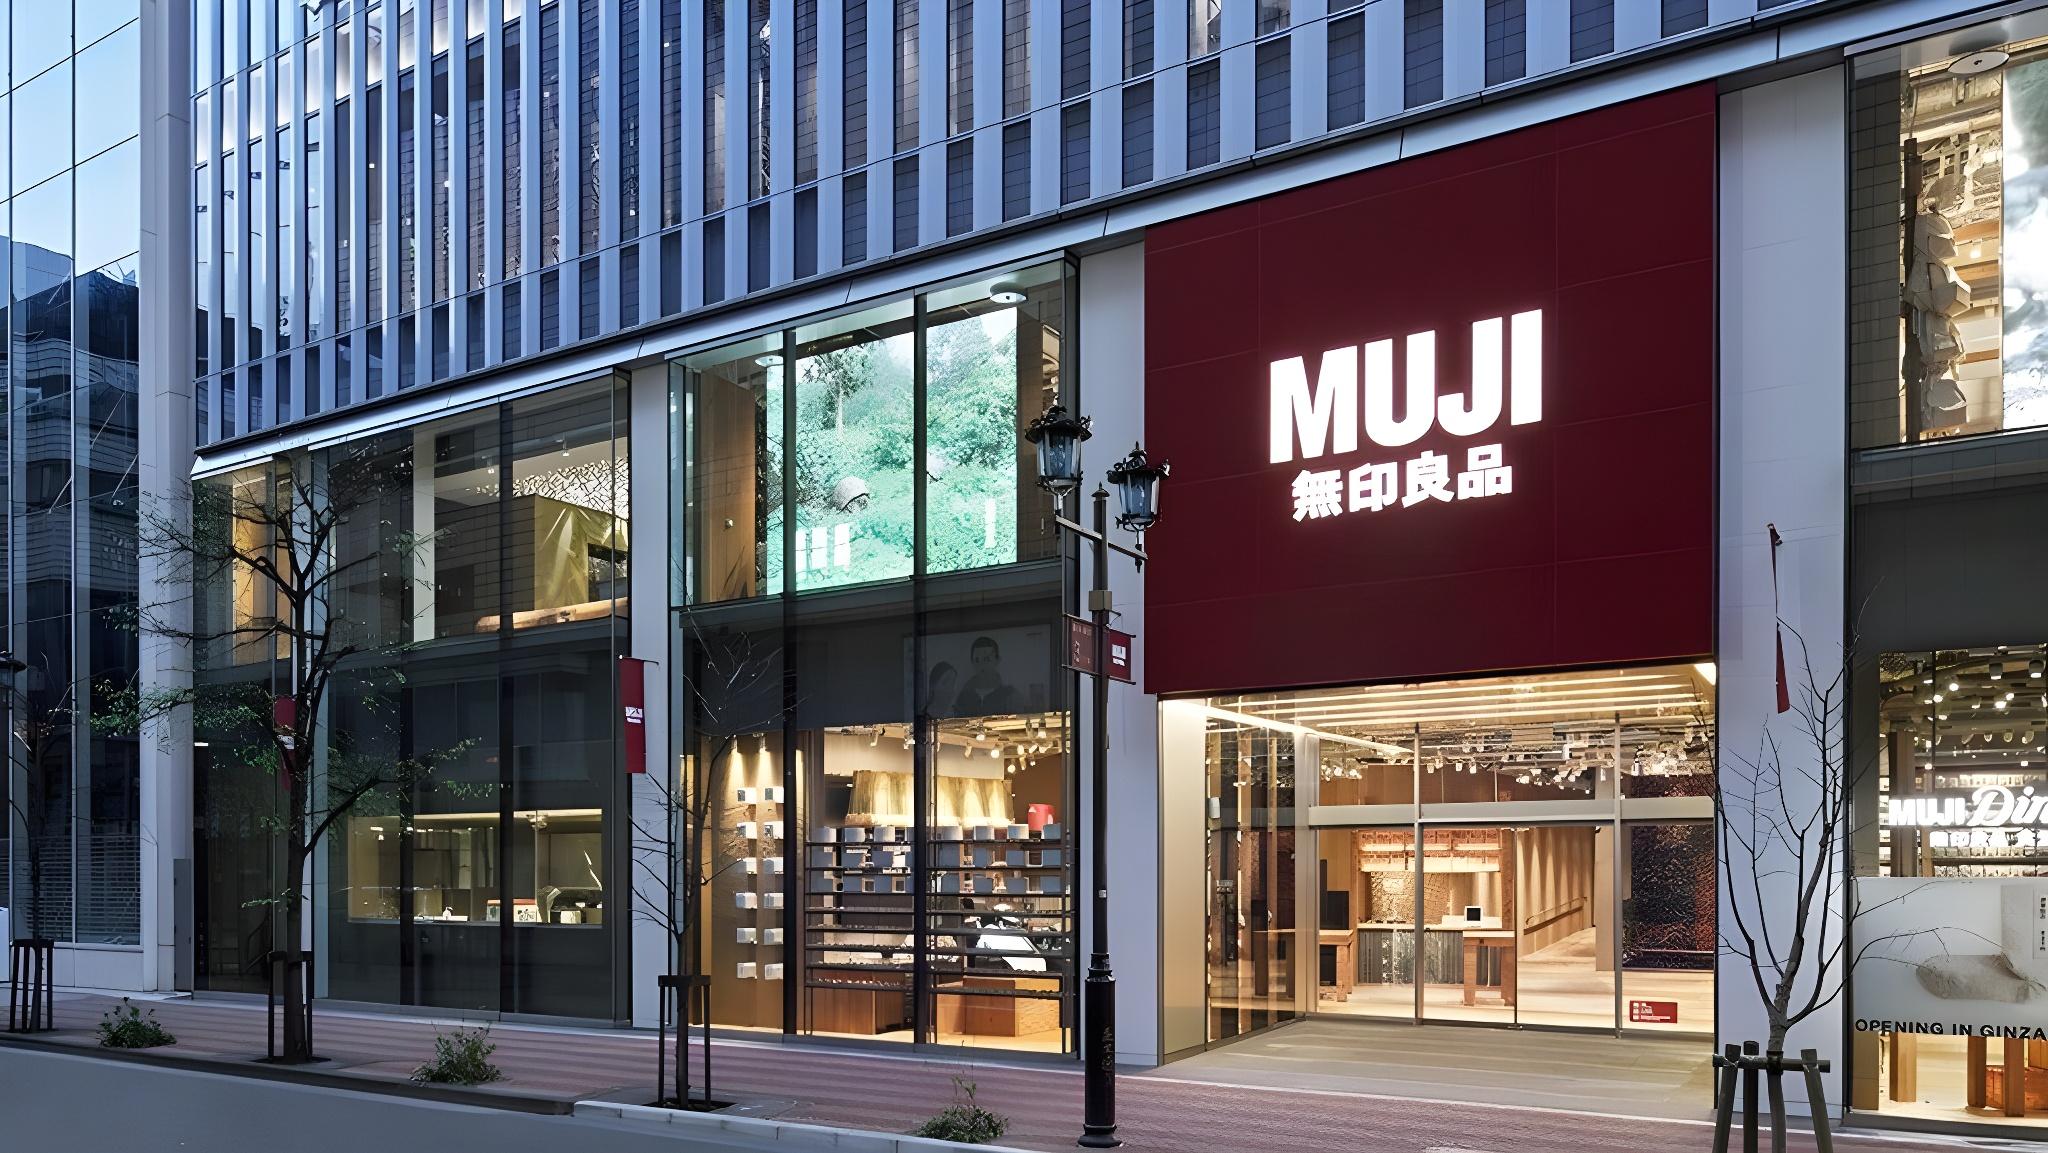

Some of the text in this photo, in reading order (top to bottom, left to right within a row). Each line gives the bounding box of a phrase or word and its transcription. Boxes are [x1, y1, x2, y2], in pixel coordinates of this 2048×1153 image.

[1270, 309, 1542, 464] MUJI
[1292, 443, 1512, 522] 無印良品
[1888, 797, 1965, 826] MUJI
[1855, 1018, 2048, 1041] OPENING IN GINZA
